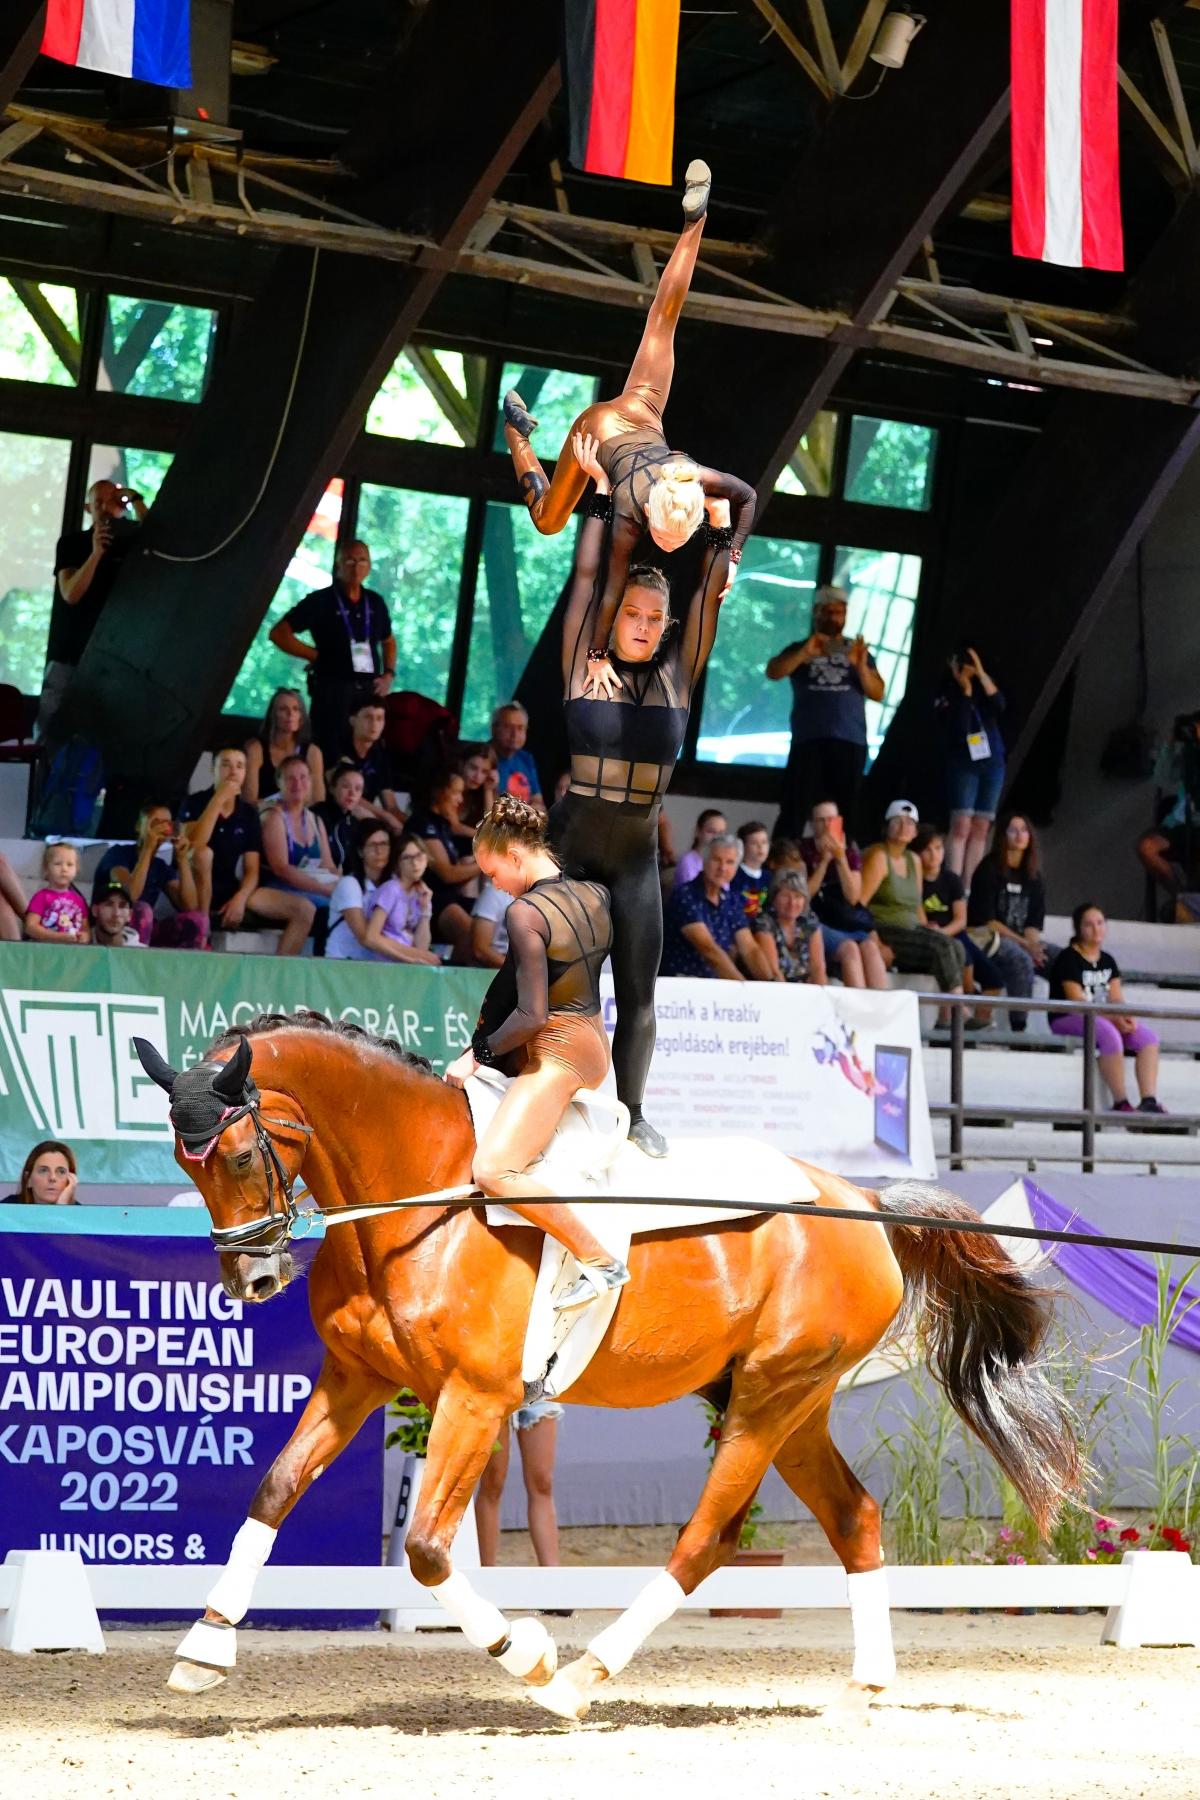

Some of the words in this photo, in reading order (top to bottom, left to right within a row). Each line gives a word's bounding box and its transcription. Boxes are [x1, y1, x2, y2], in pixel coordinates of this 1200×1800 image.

[444, 1006, 472, 1048] ÉS
[656, 1000, 696, 1020] szünk
[701, 1007, 709, 1021] a
[655, 1032, 724, 1057] egoldások
[1, 1278, 244, 1321] VAULTING
[0, 1325, 254, 1367] EUROPEAN
[0, 1371, 312, 1414] AMPIONSHIP
[0, 1415, 255, 1466] KAPOSVÁR
[60, 1472, 178, 1511] 2022
[184, 1533, 206, 1560] &
